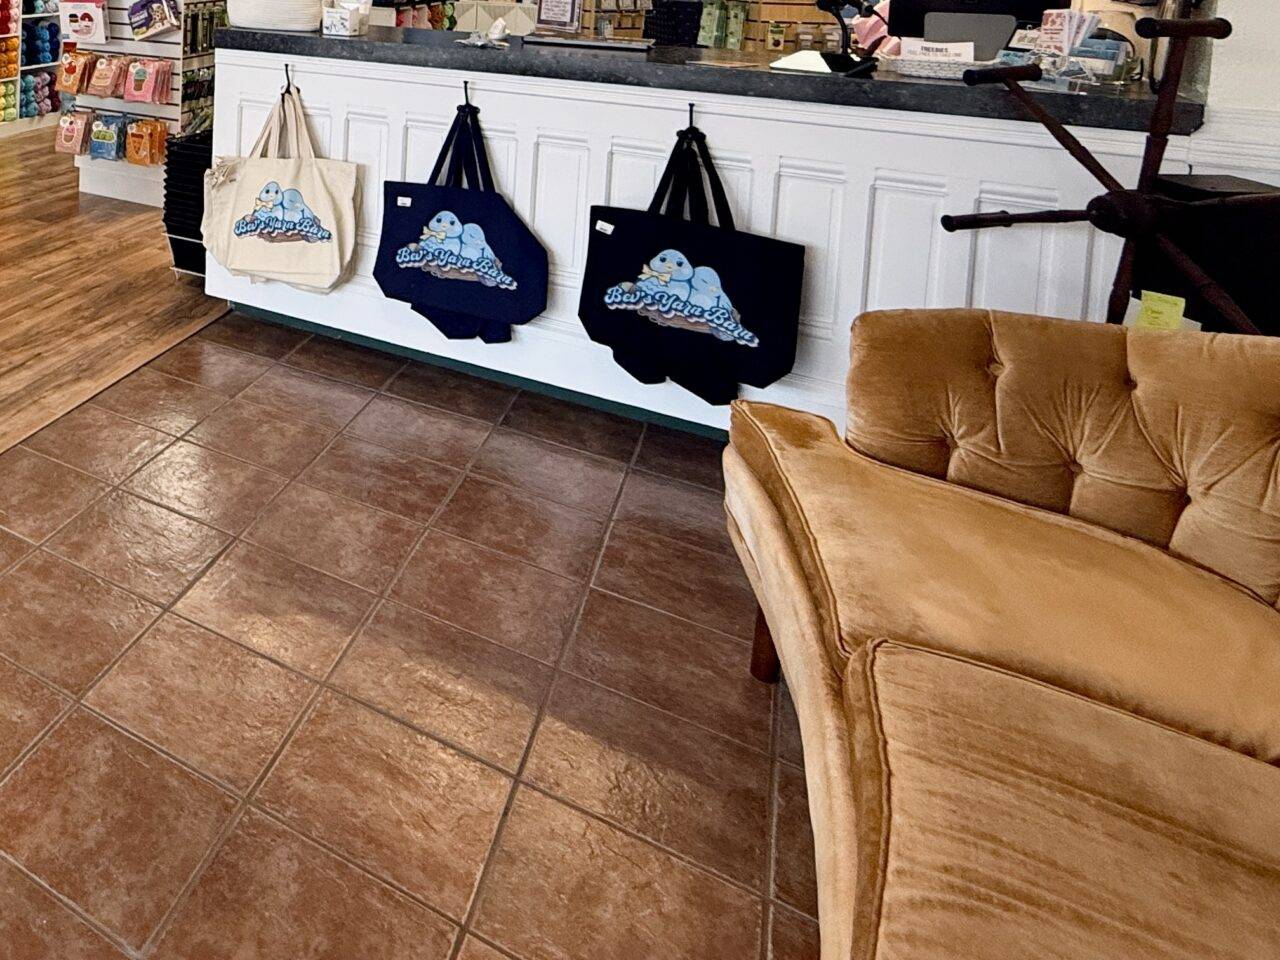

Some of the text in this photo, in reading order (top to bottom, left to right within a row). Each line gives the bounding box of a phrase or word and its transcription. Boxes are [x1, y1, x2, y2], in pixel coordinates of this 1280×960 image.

[235, 218, 331, 238] Bev's Yarn Barn
[396, 247, 512, 285] Bev's Yarn Barn
[604, 287, 754, 340] Bev's Yarn Barn
